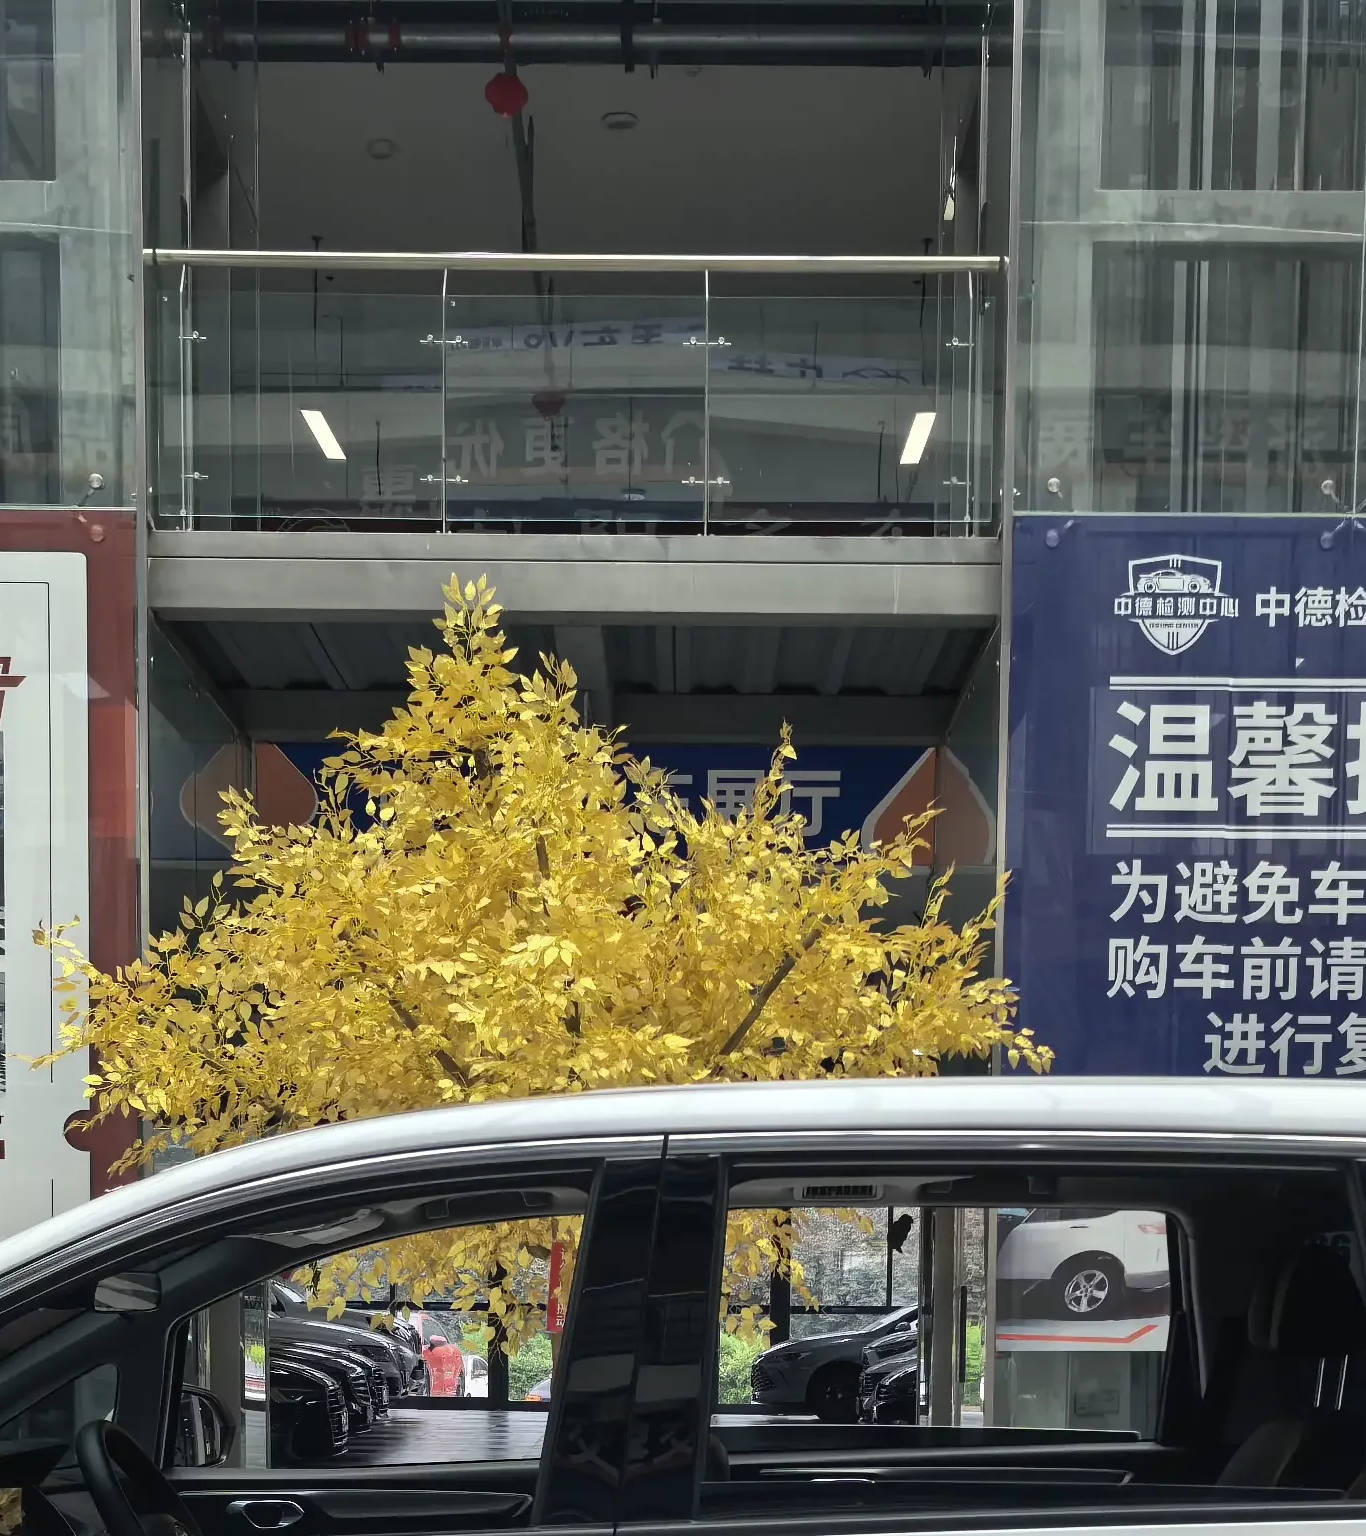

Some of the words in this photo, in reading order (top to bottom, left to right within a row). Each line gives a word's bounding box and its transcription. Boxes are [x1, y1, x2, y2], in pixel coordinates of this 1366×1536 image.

[1113, 596, 1239, 618] 中德检测中心
